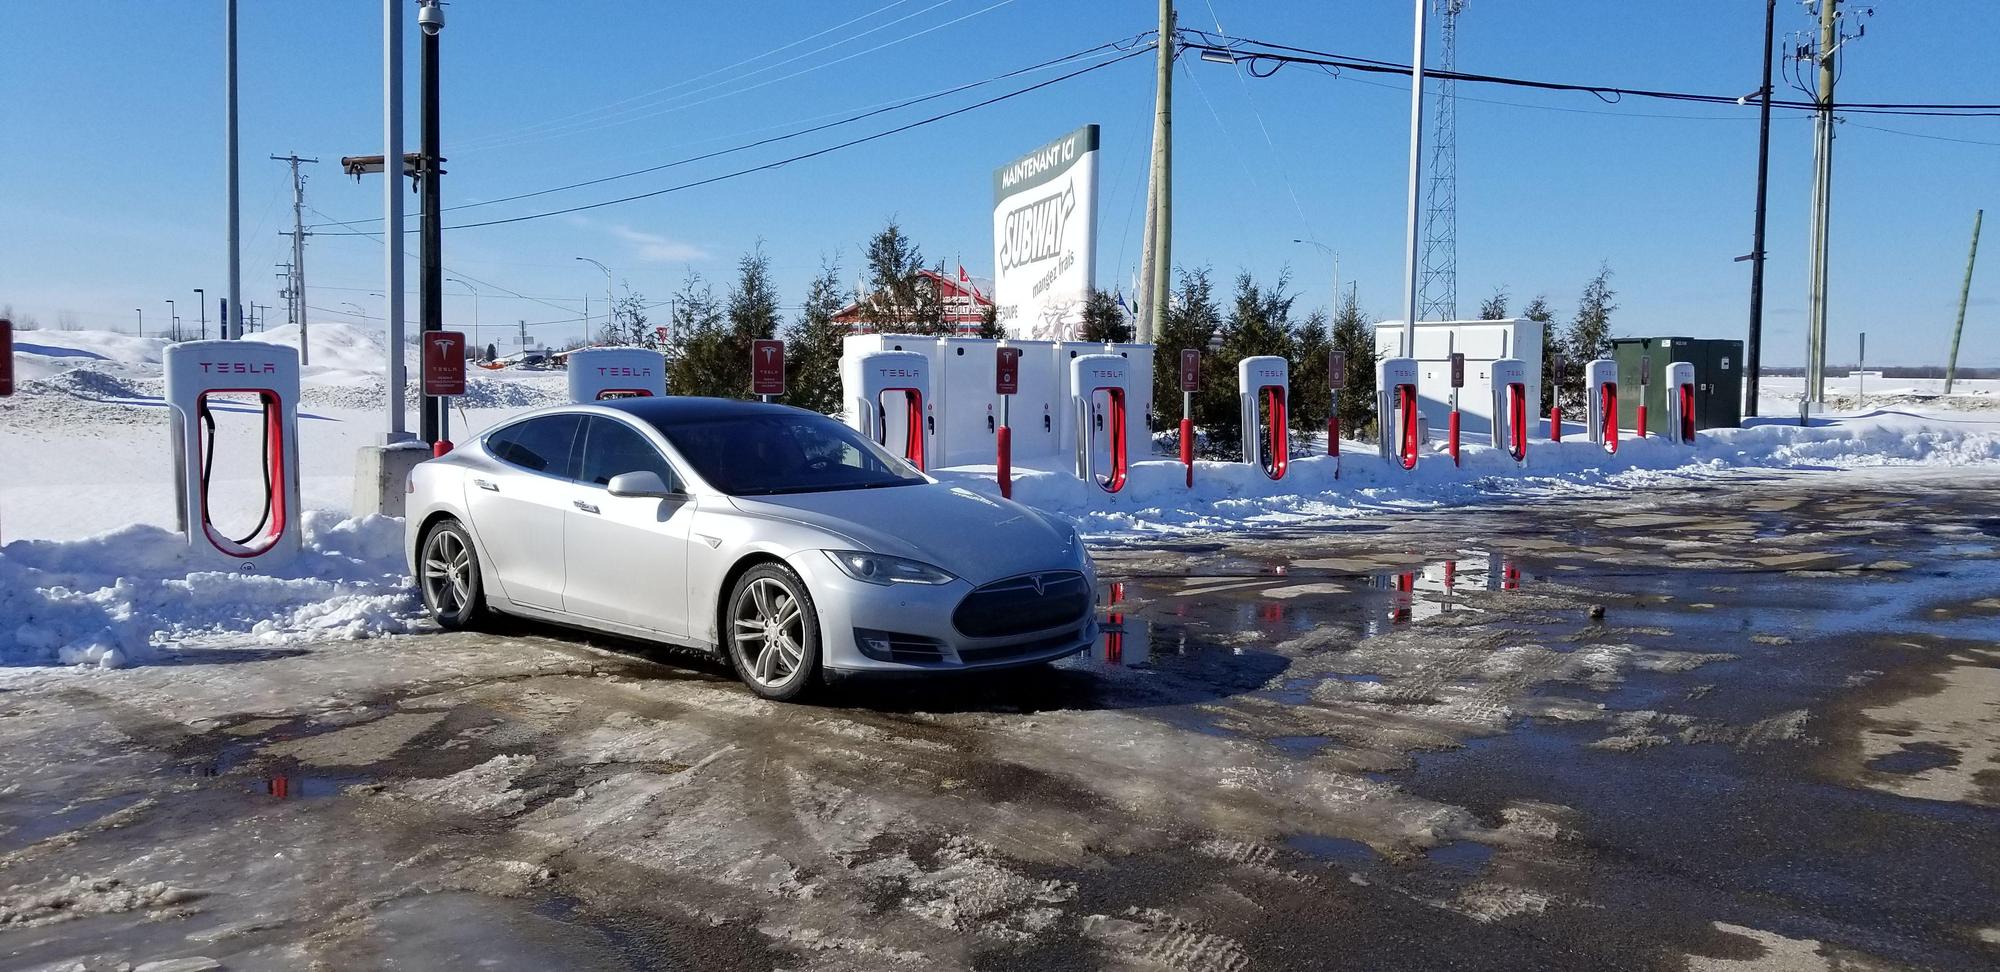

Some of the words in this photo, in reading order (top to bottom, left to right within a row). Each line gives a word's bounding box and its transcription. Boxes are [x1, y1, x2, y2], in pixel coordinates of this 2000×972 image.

[1002, 147, 1060, 189] MAINTENANT
[1061, 138, 1075, 161] ICI
[1001, 183, 1075, 273] SUBWAY
[1032, 268, 1058, 299] mangez
[1058, 250, 1075, 277] frais
[199, 363, 275, 375] TESLA
[597, 367, 652, 377] TESLA
[879, 369, 919, 377] TESLA
[1092, 370, 1123, 378] TESLA
